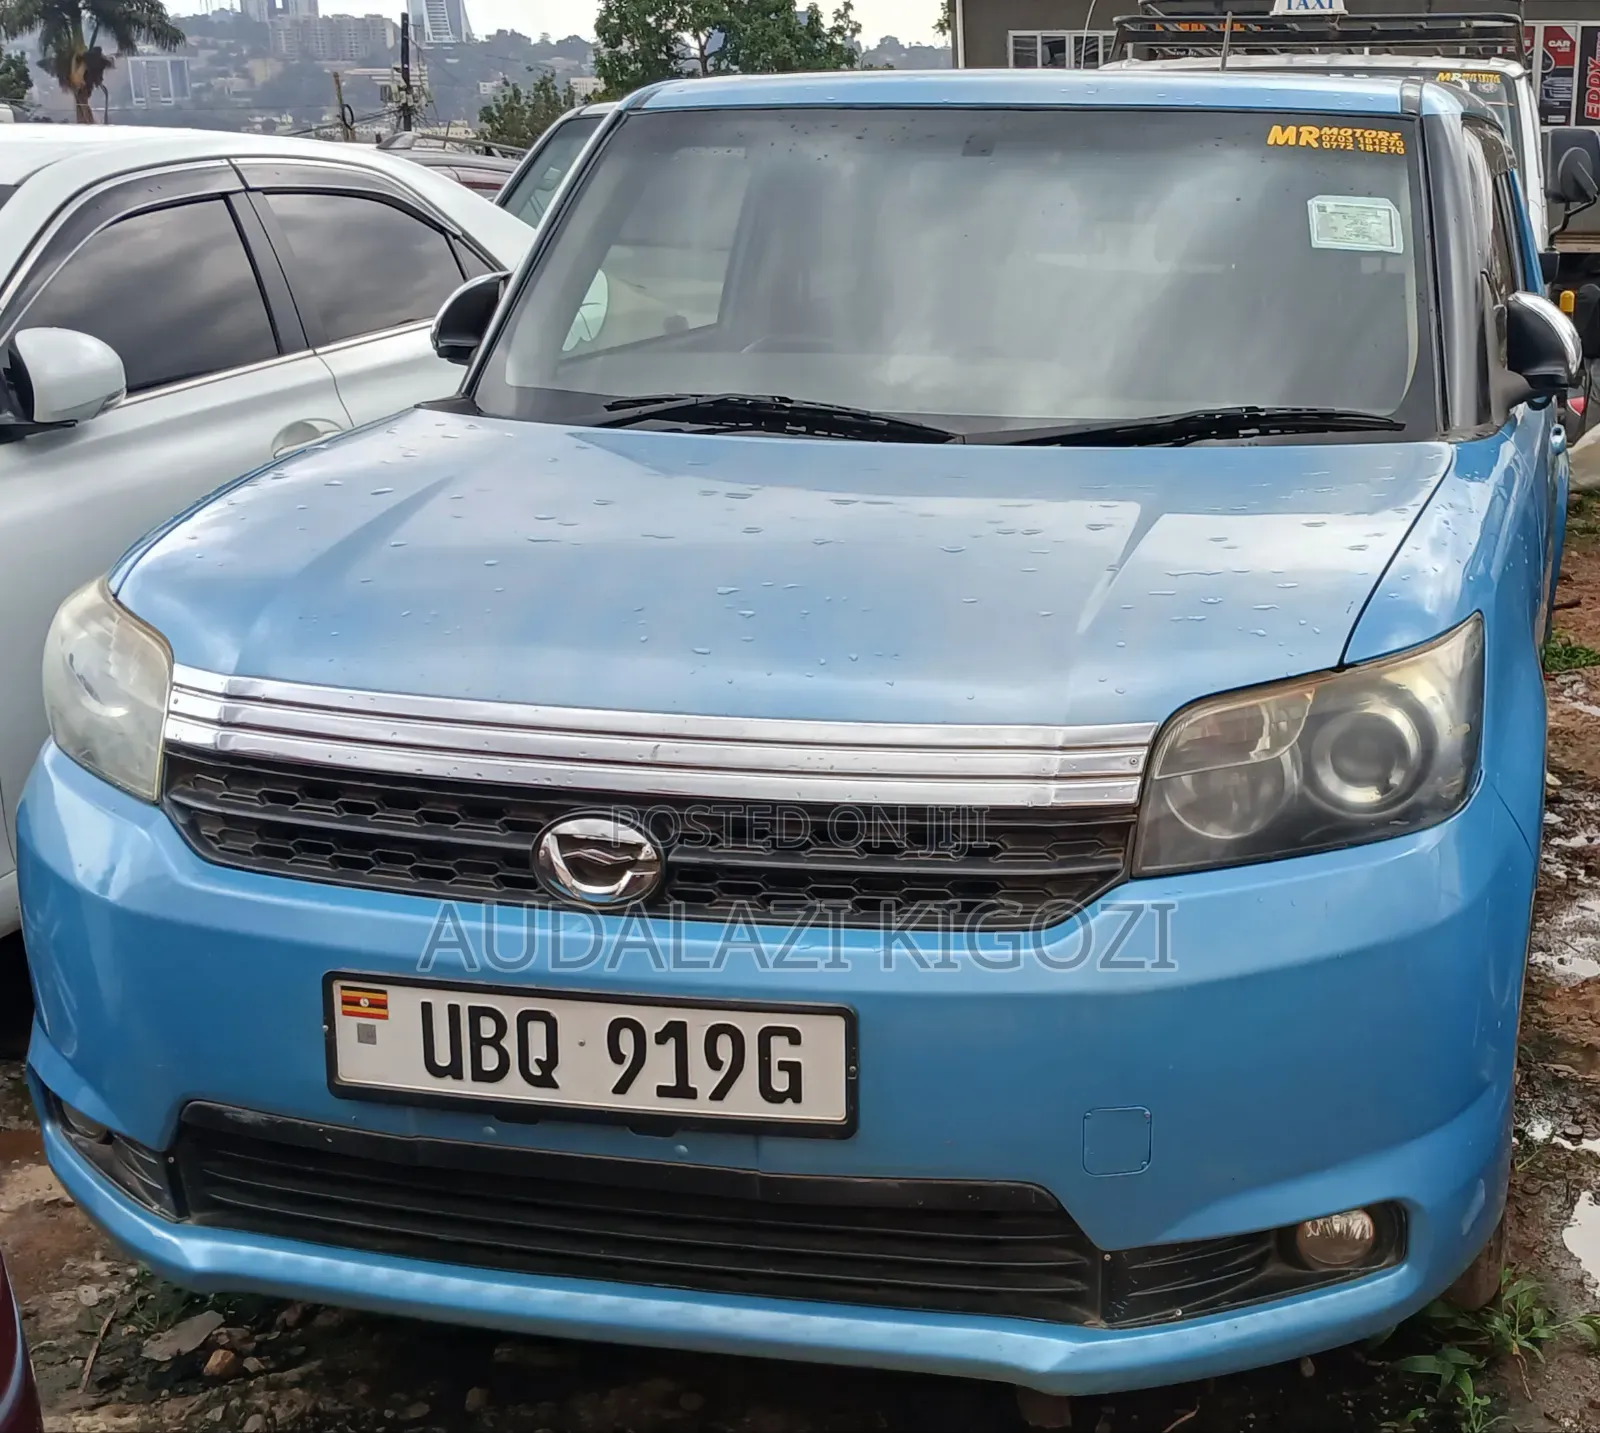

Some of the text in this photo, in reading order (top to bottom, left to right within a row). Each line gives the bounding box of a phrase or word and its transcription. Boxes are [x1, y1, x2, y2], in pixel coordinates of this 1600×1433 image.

[1548, 40, 1571, 48] CAR
[1584, 56, 1600, 119] EDDY
[1266, 124, 1402, 148] MR MOTORS
[1321, 134, 1404, 147] 0703 181270
[1321, 142, 1405, 155] 0772 181270
[421, 1000, 803, 1106] UBQ 919G
